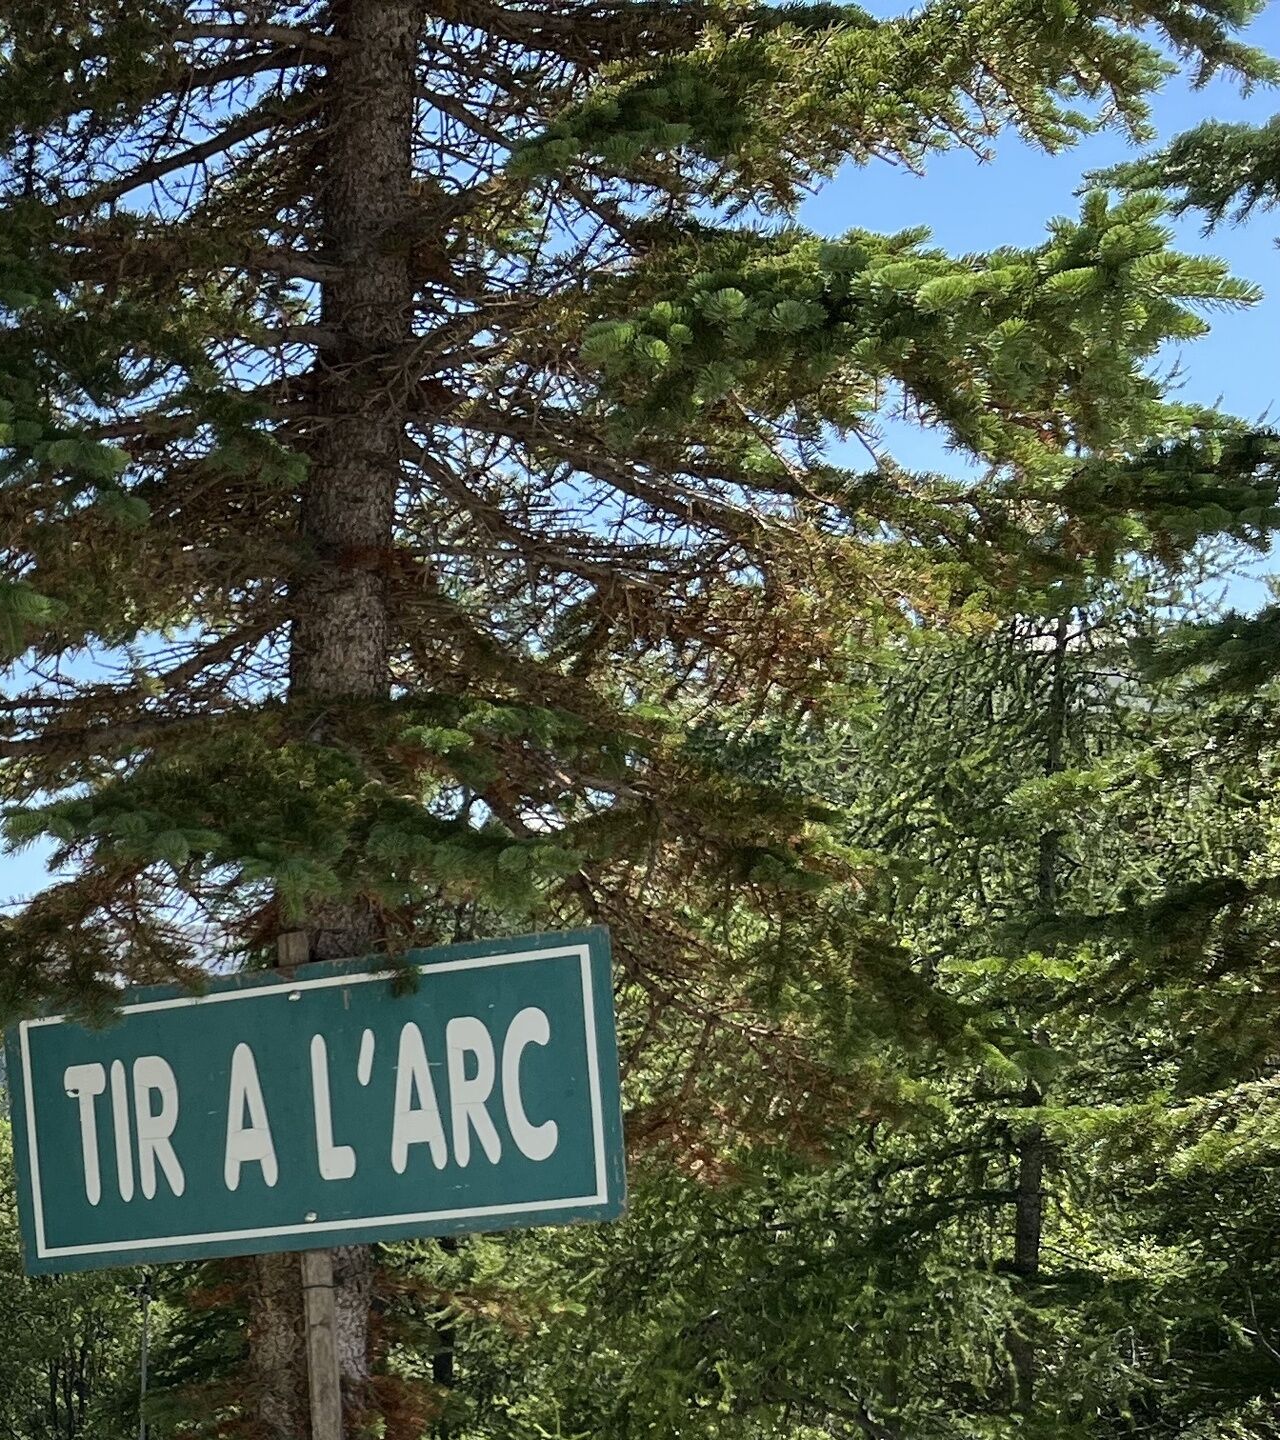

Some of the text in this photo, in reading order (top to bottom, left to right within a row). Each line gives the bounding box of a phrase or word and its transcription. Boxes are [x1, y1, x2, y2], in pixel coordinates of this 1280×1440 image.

[63, 1006, 559, 1207] TIR A L'ARC
